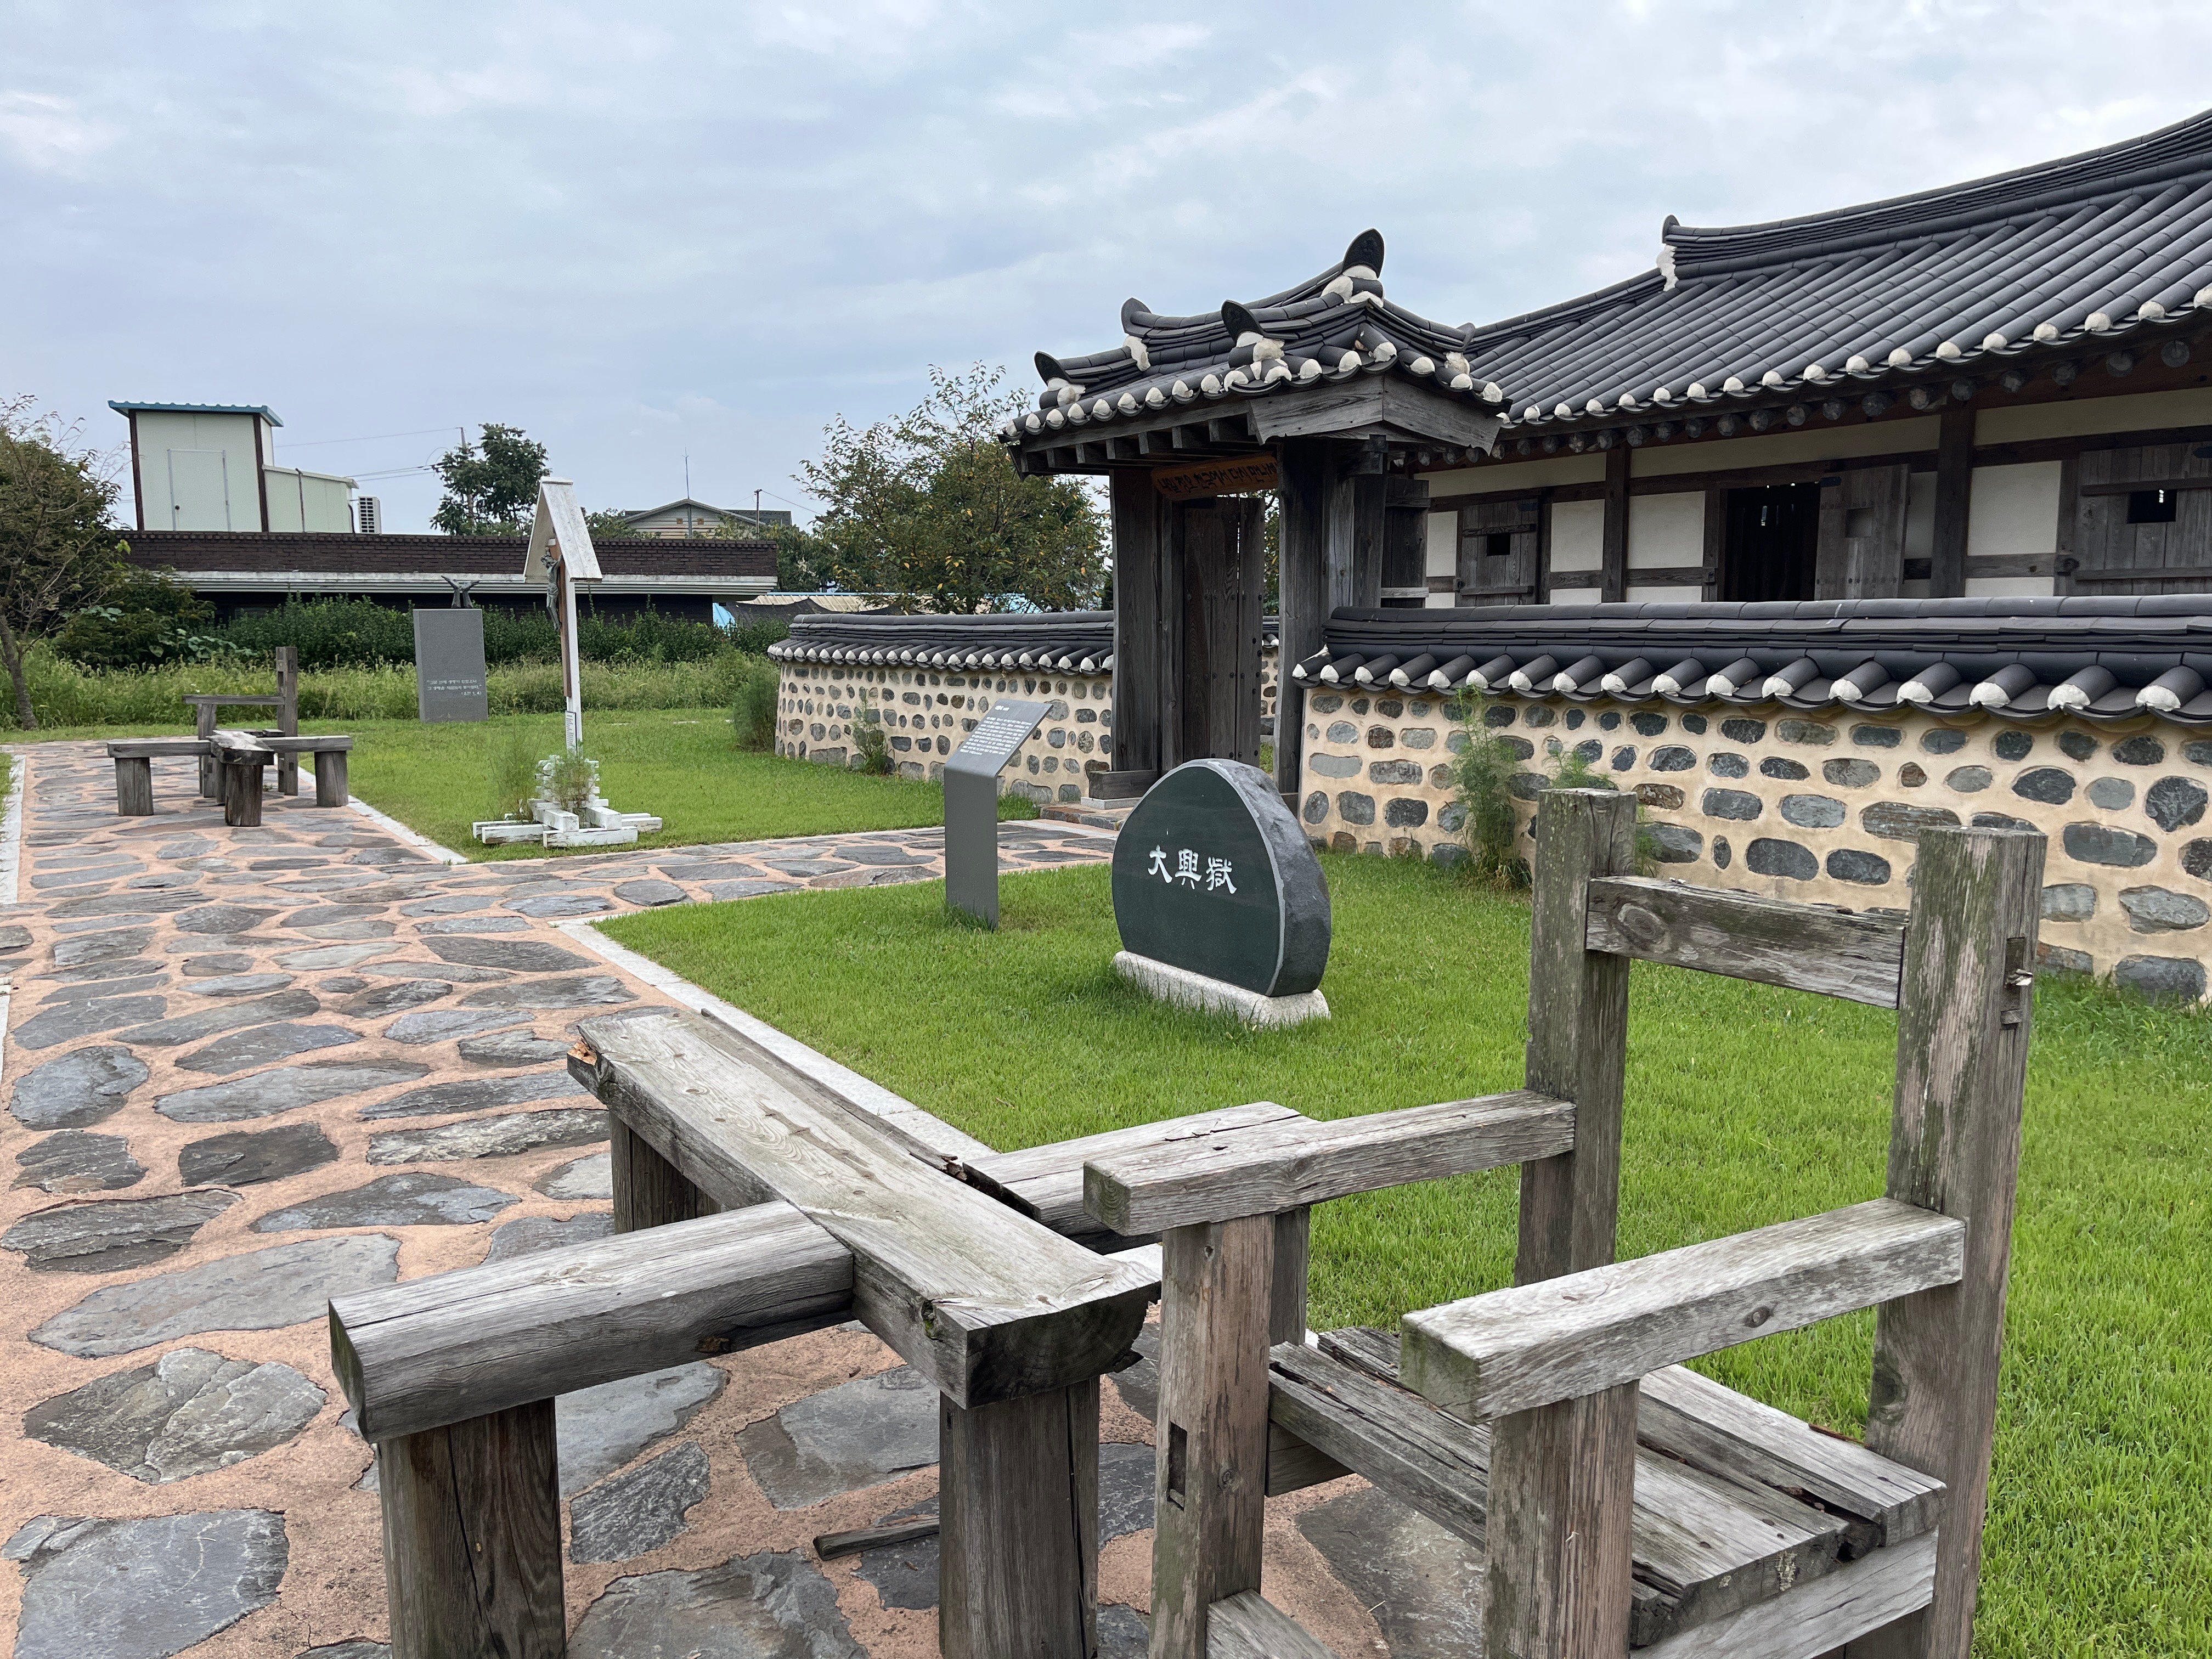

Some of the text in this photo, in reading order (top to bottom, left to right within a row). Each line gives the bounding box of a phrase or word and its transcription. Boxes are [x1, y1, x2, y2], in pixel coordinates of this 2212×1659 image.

[1158, 477, 1181, 493] 내일
[1193, 469, 1233, 489] 천국에서
[1227, 466, 1252, 482] 다시
[1148, 844, 1237, 894] 大興獄
